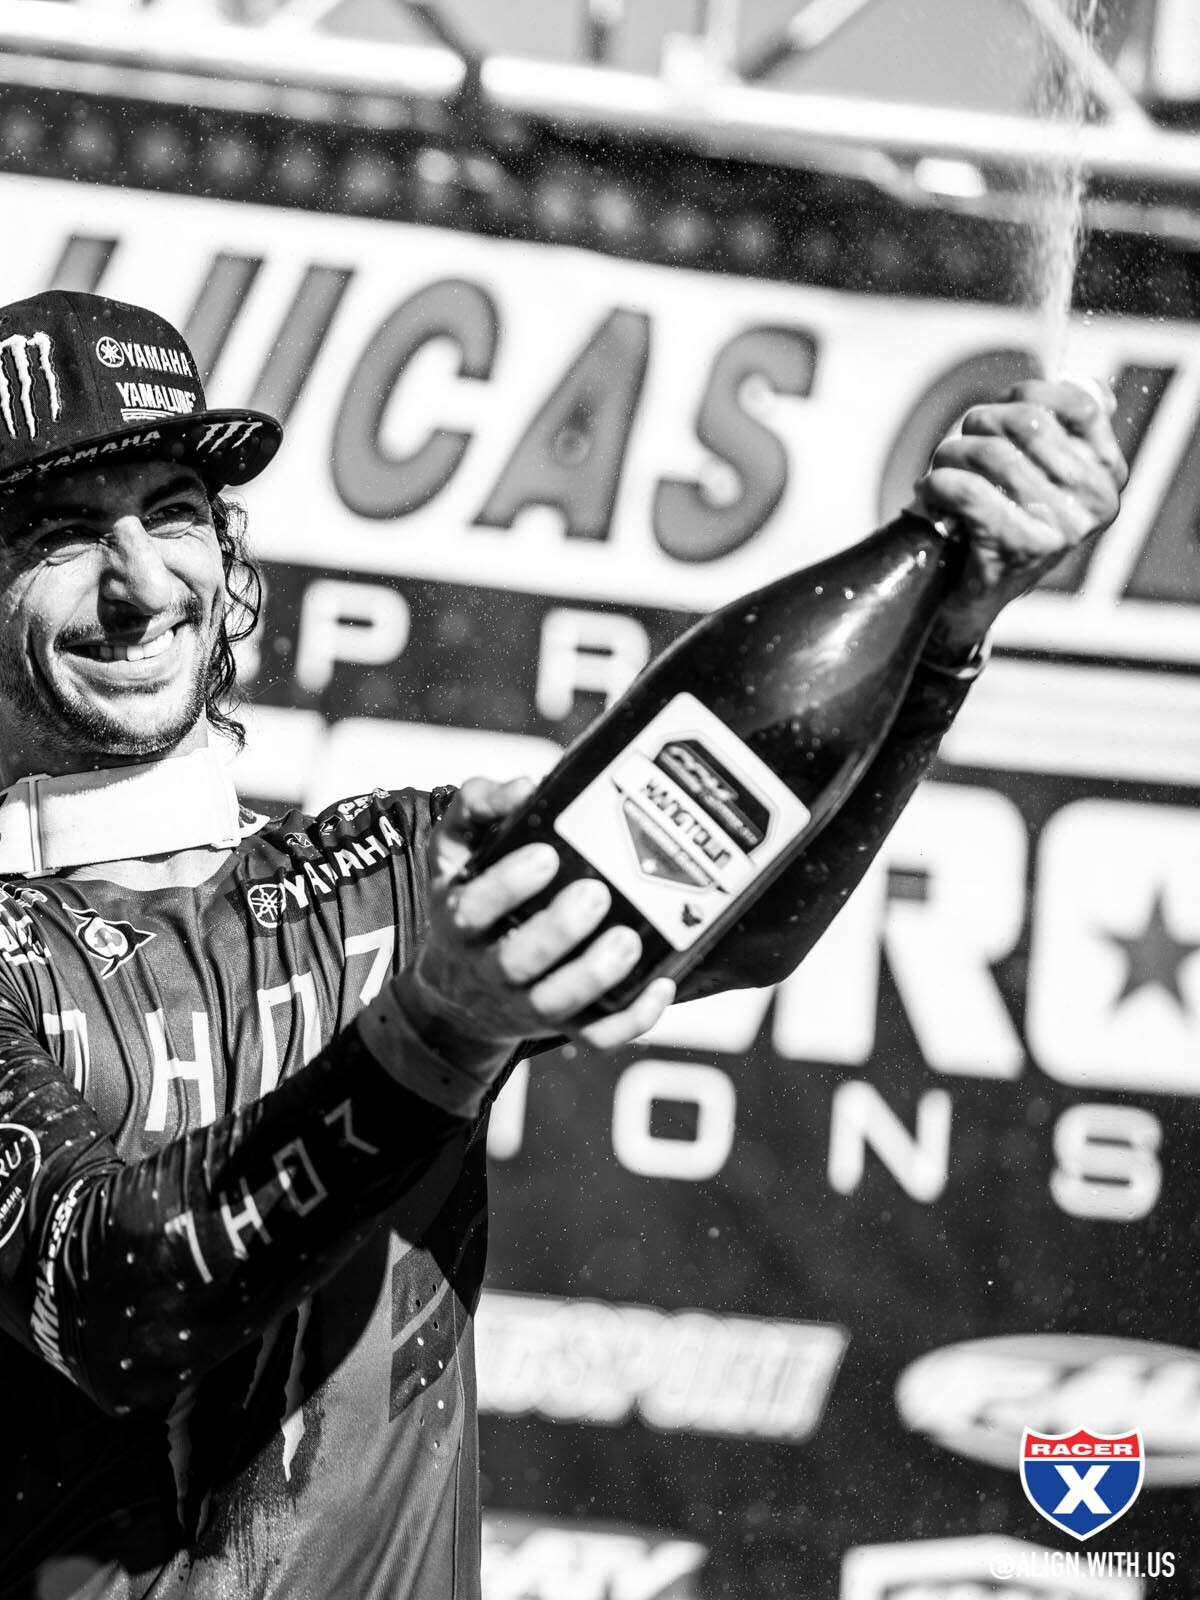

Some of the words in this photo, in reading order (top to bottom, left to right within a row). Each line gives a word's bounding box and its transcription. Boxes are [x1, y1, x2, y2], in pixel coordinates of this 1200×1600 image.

[119, 341, 193, 378] YAMAHA
[48, 236, 820, 564] UCAS
[36, 430, 161, 472] YAMAHA
